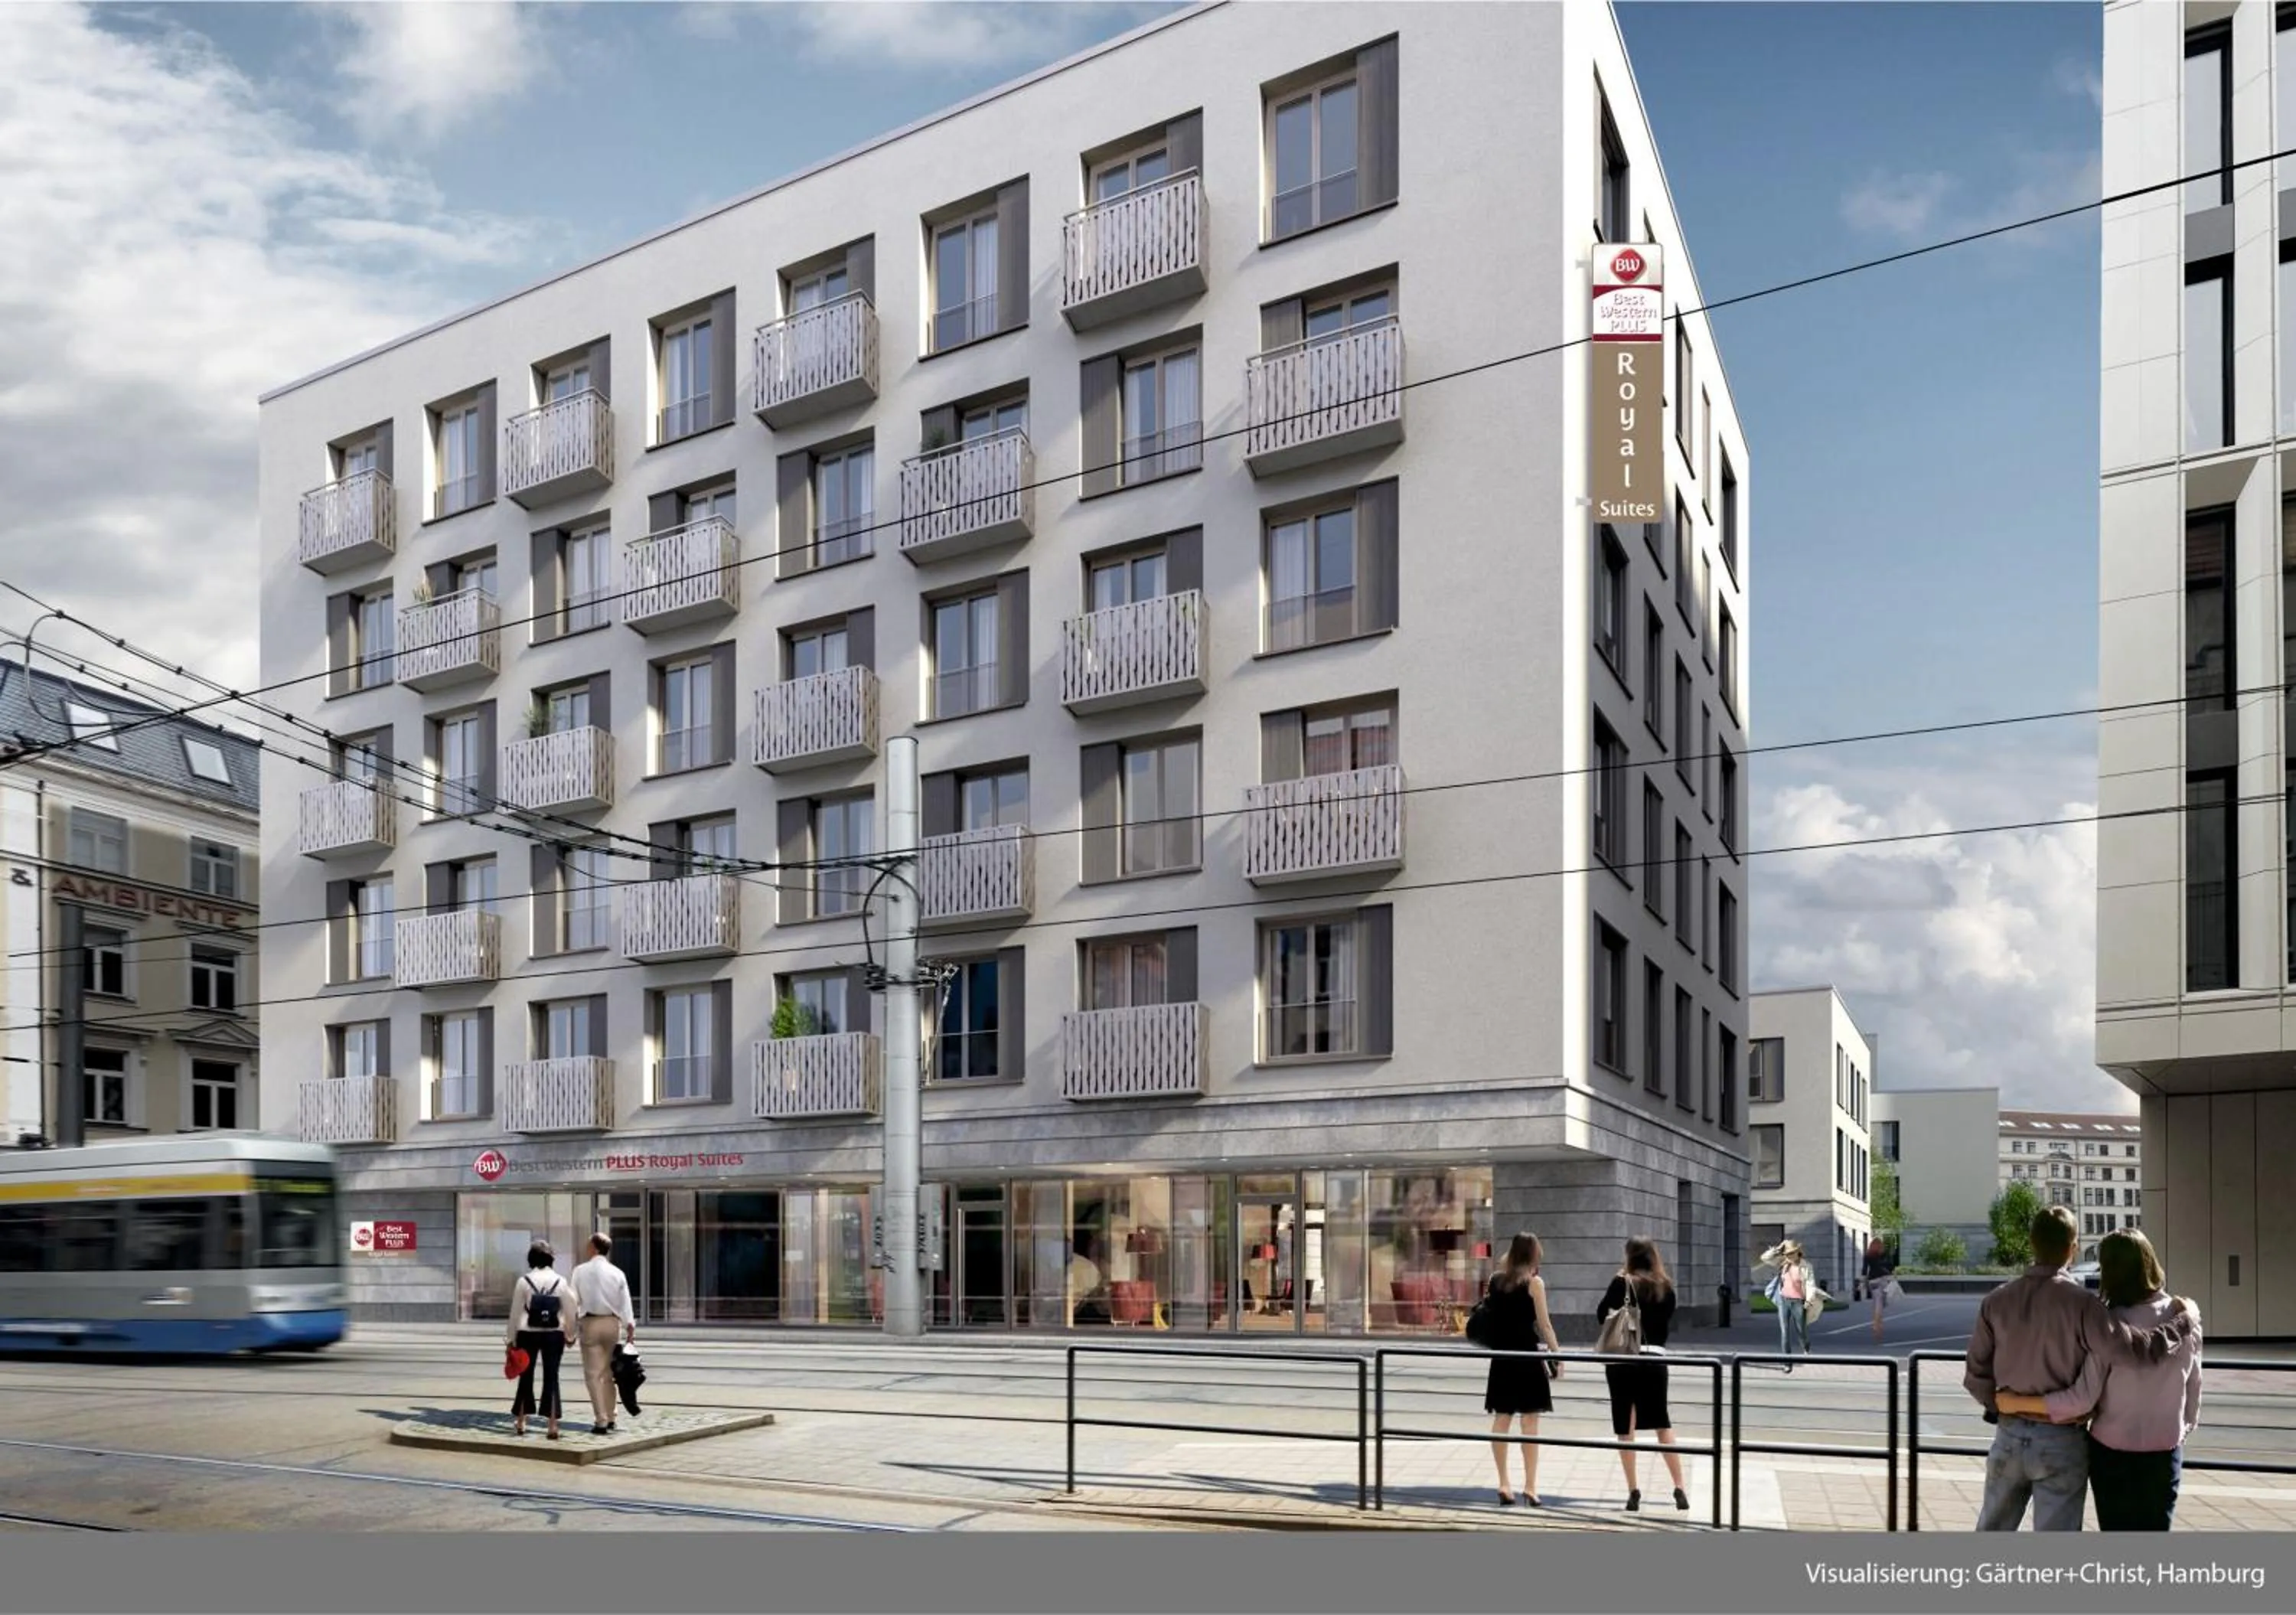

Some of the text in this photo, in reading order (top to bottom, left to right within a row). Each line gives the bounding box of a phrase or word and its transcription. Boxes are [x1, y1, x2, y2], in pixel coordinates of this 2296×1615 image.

[1616, 258, 1640, 272] BW
[1614, 293, 1645, 305] Best
[1600, 305, 1658, 318] Western
[1609, 320, 1648, 332] PLUS
[1616, 352, 1636, 488] Royal
[1600, 500, 1655, 517] Suites
[51, 876, 242, 928] AMBIENTE
[478, 1159, 501, 1173] BW
[509, 1160, 538, 1173] Best
[606, 1155, 645, 1170] PLUS
[650, 1153, 693, 1170] Royal
[697, 1151, 744, 1167] Suites
